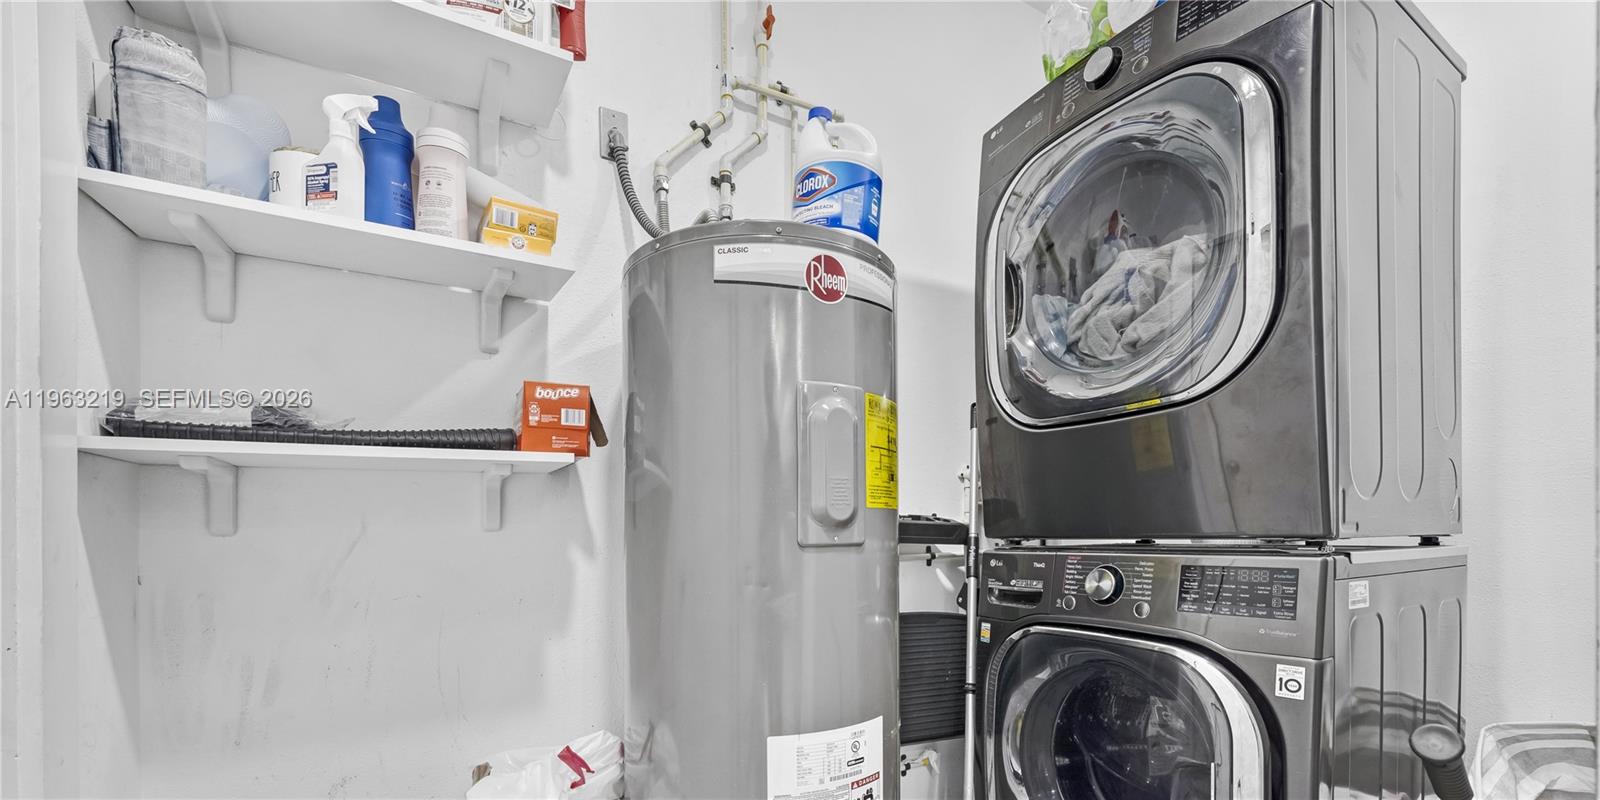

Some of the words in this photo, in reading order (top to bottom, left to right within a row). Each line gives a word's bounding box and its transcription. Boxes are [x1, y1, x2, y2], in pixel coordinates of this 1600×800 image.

[795, 175, 830, 197] CLOROX
[717, 246, 750, 255] CLASSIC
[810, 254, 847, 295] Rheem
[535, 386, 580, 400] bounce
[1278, 677, 1302, 694] 10
[859, 772, 879, 787] DANGER
